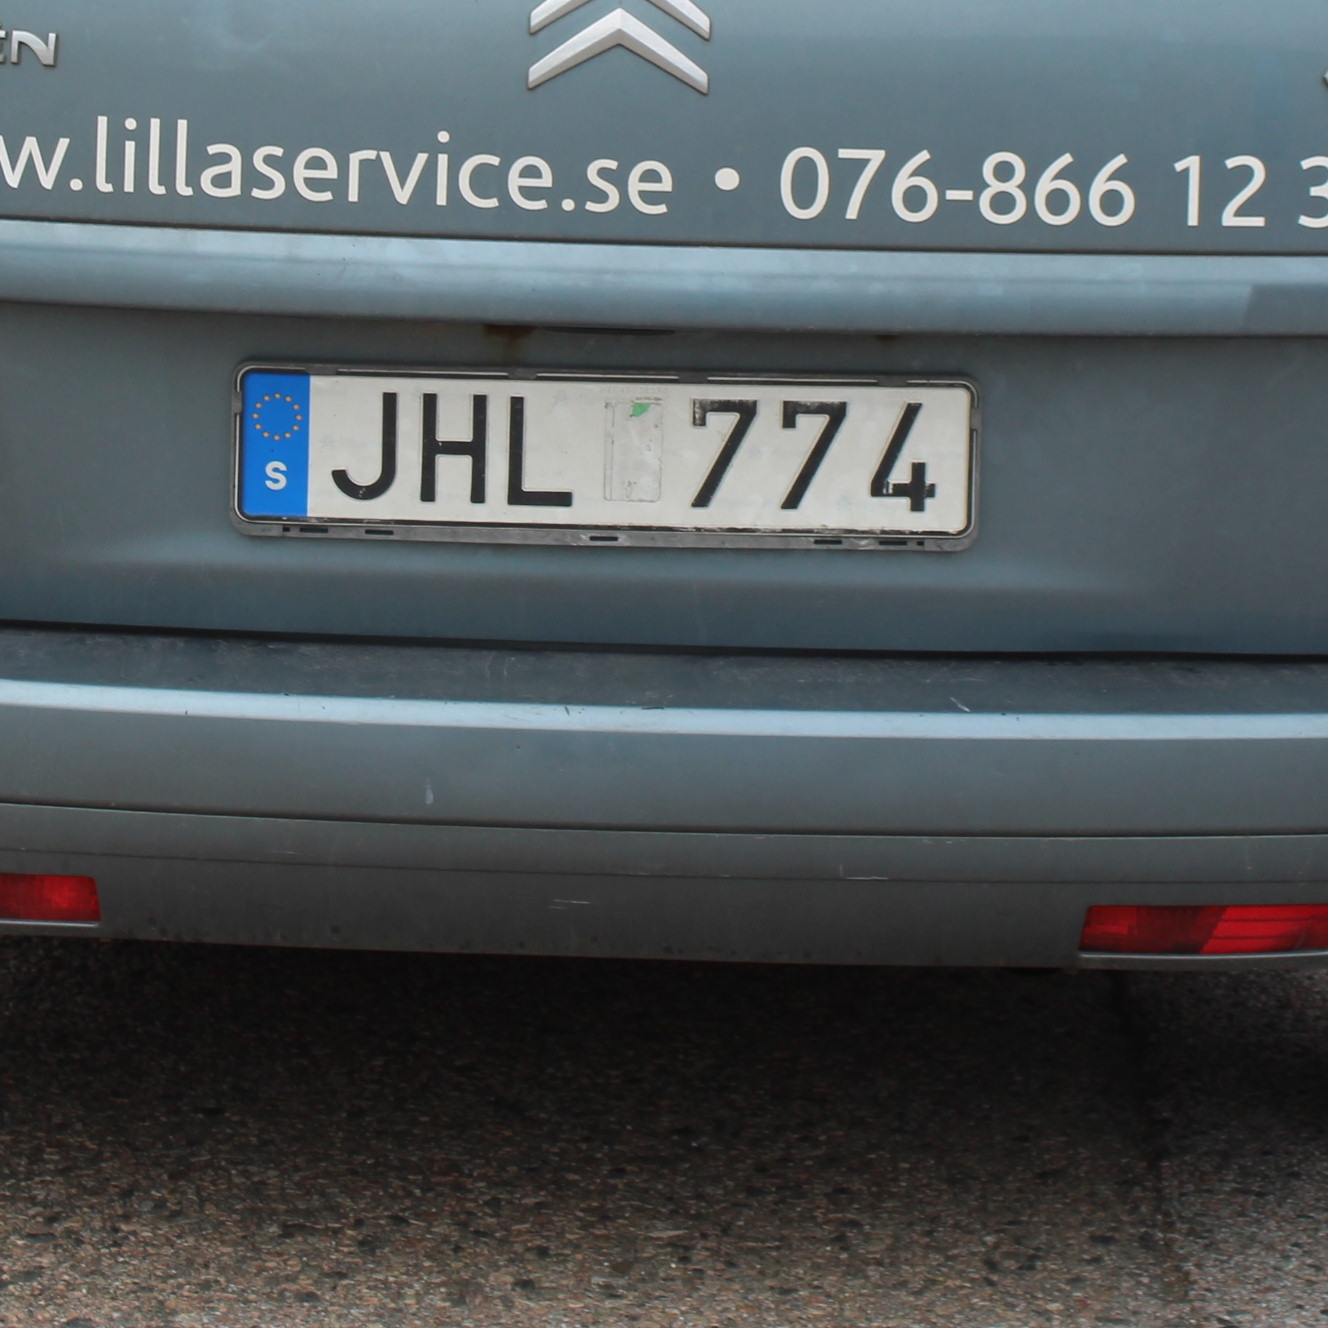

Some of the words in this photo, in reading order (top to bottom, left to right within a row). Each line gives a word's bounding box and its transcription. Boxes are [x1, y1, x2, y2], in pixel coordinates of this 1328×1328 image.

[779, 146, 1136, 227] 076-866
[1173, 154, 1266, 227] 12
[330, 390, 574, 509] JHL
[689, 398, 937, 514] 774
